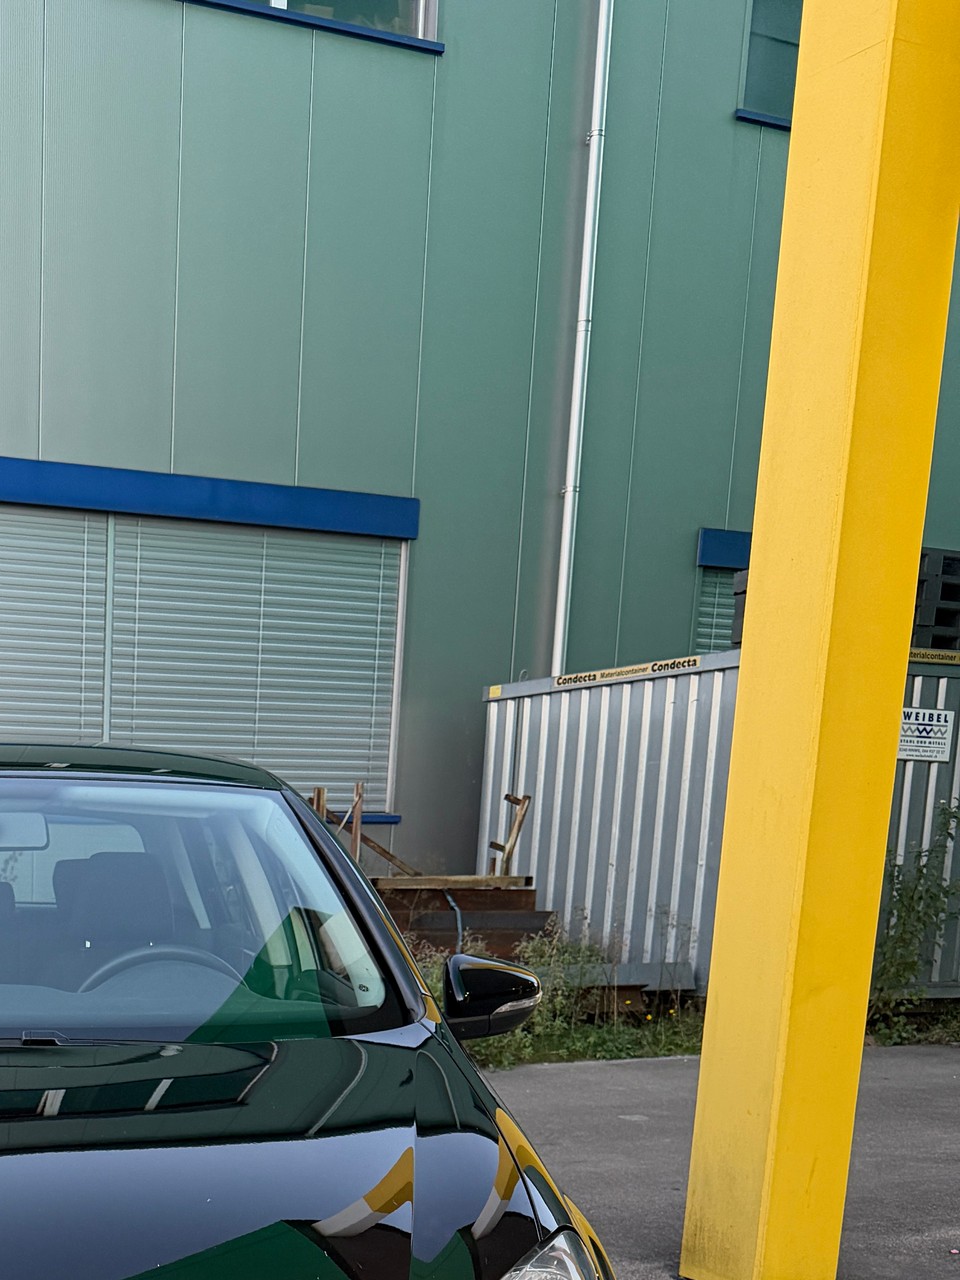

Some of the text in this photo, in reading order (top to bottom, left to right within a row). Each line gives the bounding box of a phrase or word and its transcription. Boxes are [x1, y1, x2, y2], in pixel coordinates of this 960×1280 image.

[909, 650, 957, 661] terialcontainer
[556, 658, 697, 685] Condecta Materialcontainer Condecta
[903, 711, 949, 723] WEIBEL
